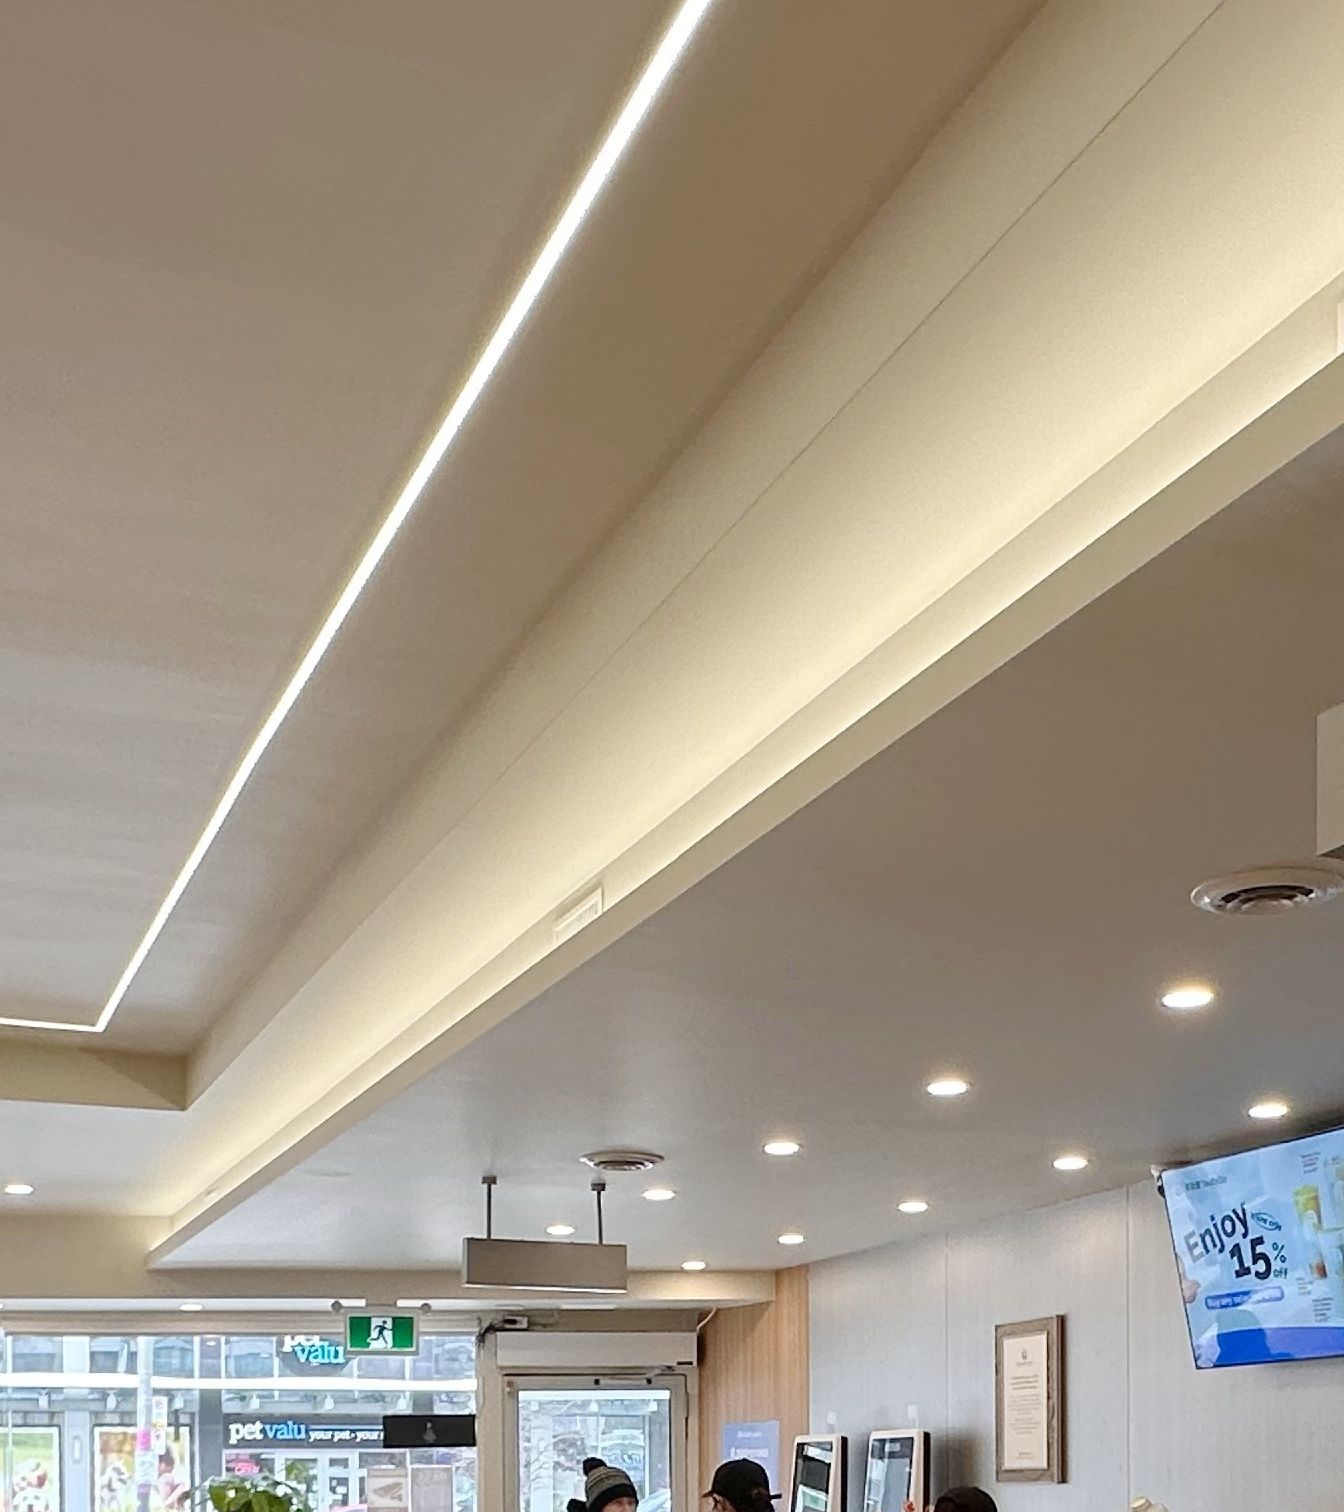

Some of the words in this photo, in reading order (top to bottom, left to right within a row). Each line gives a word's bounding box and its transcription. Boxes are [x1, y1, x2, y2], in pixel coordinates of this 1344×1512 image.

[1183, 1202, 1250, 1263] Enjoy
[294, 1341, 345, 1363] valu
[228, 1420, 263, 1445] pet
[264, 1420, 306, 1440] valu
